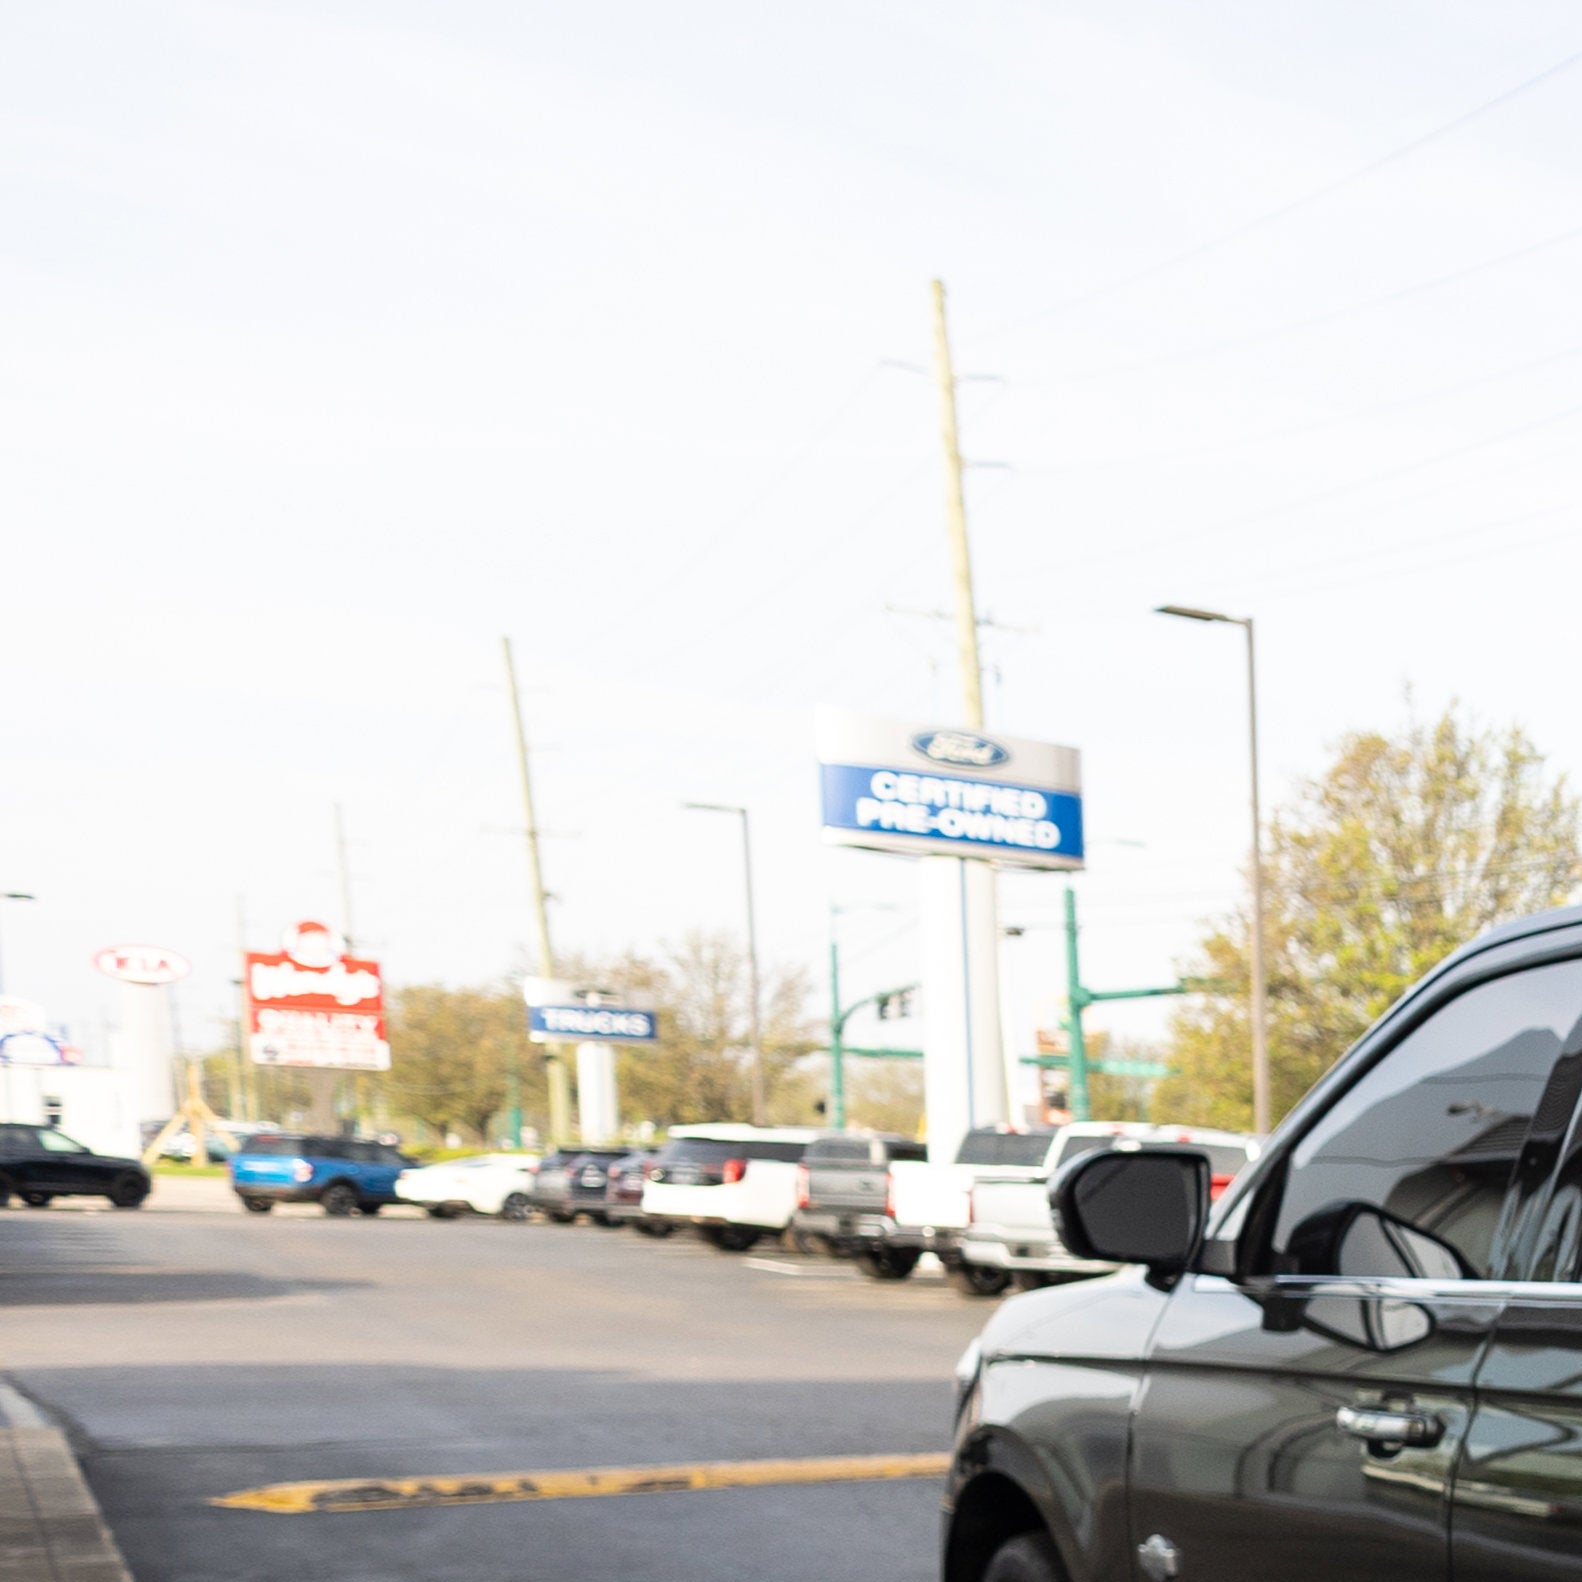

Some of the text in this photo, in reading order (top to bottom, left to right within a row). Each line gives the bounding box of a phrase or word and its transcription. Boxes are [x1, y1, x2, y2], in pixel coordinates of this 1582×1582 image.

[870, 770, 1048, 820] CERTIFIED
[855, 796, 1062, 850] PRE-OWNED
[540, 1007, 651, 1037] TRUCKS
